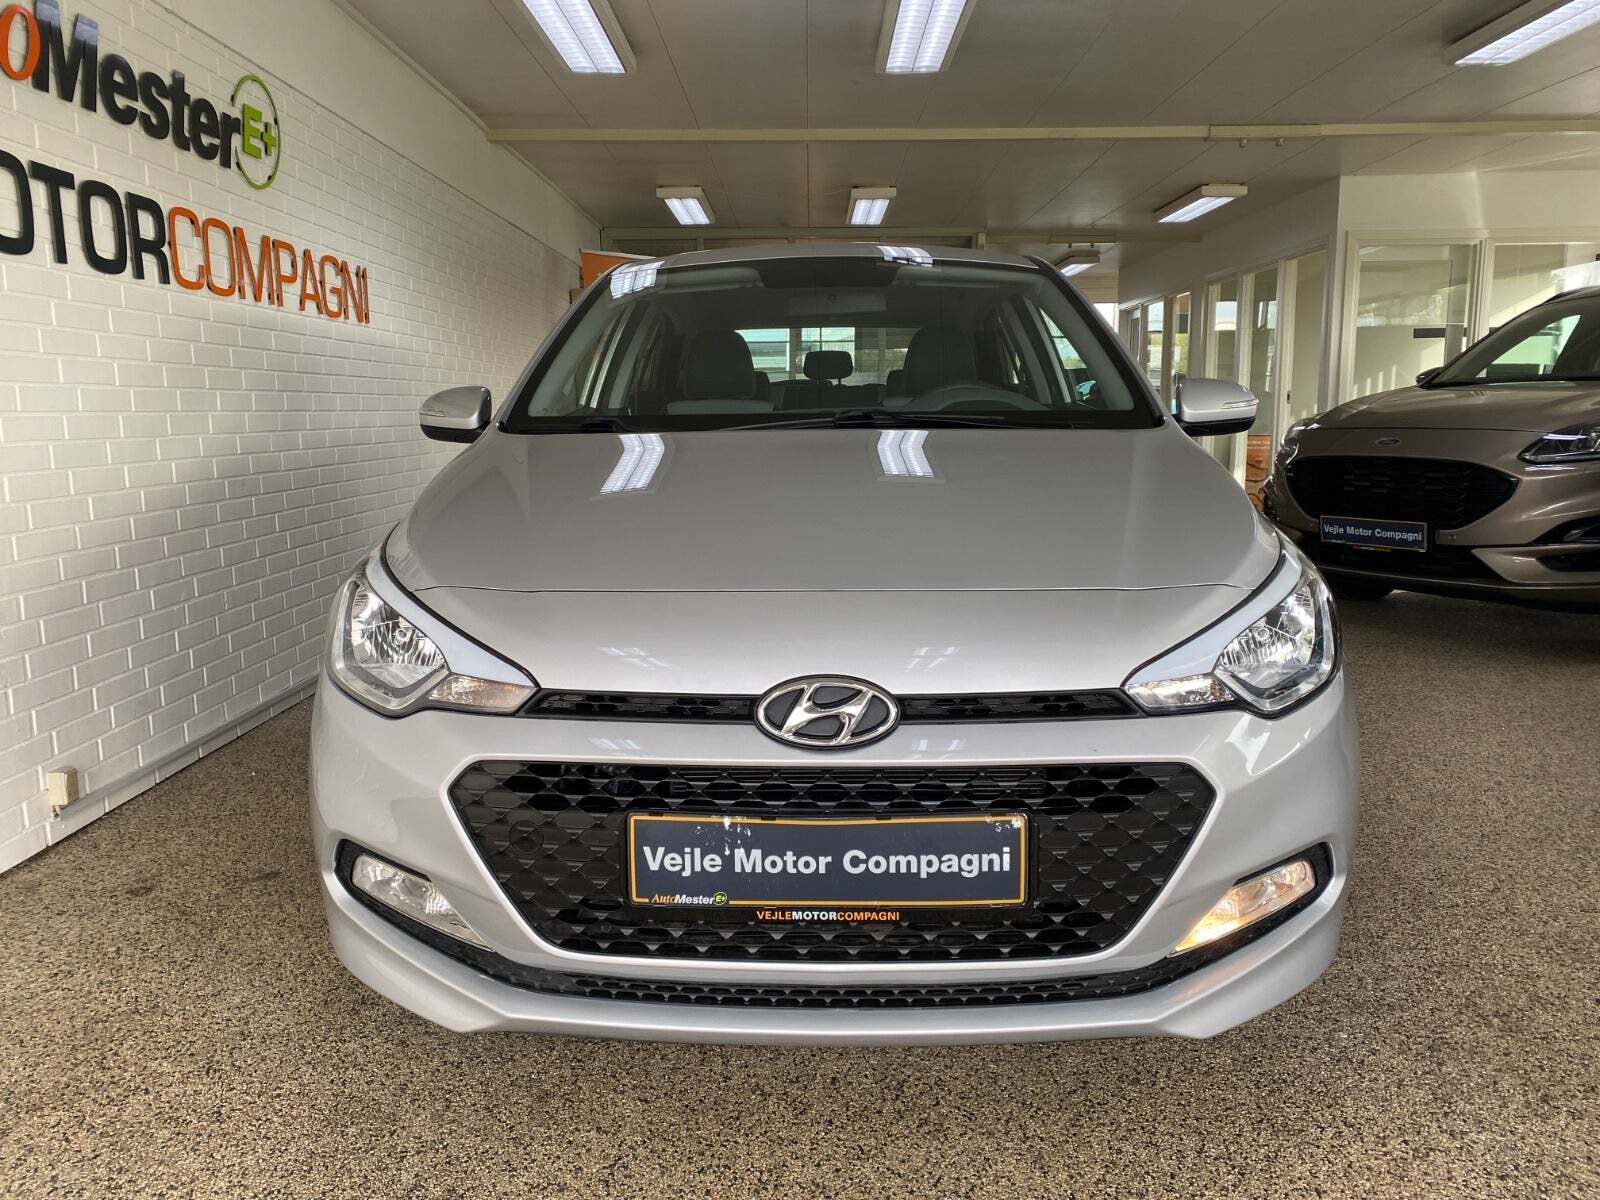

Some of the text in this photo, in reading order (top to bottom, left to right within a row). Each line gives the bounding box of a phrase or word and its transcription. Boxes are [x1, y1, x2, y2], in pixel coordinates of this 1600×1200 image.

[1324, 524, 1422, 541] Vejle Motor Compagni
[643, 846, 1011, 878] Vejle Motor Compagni
